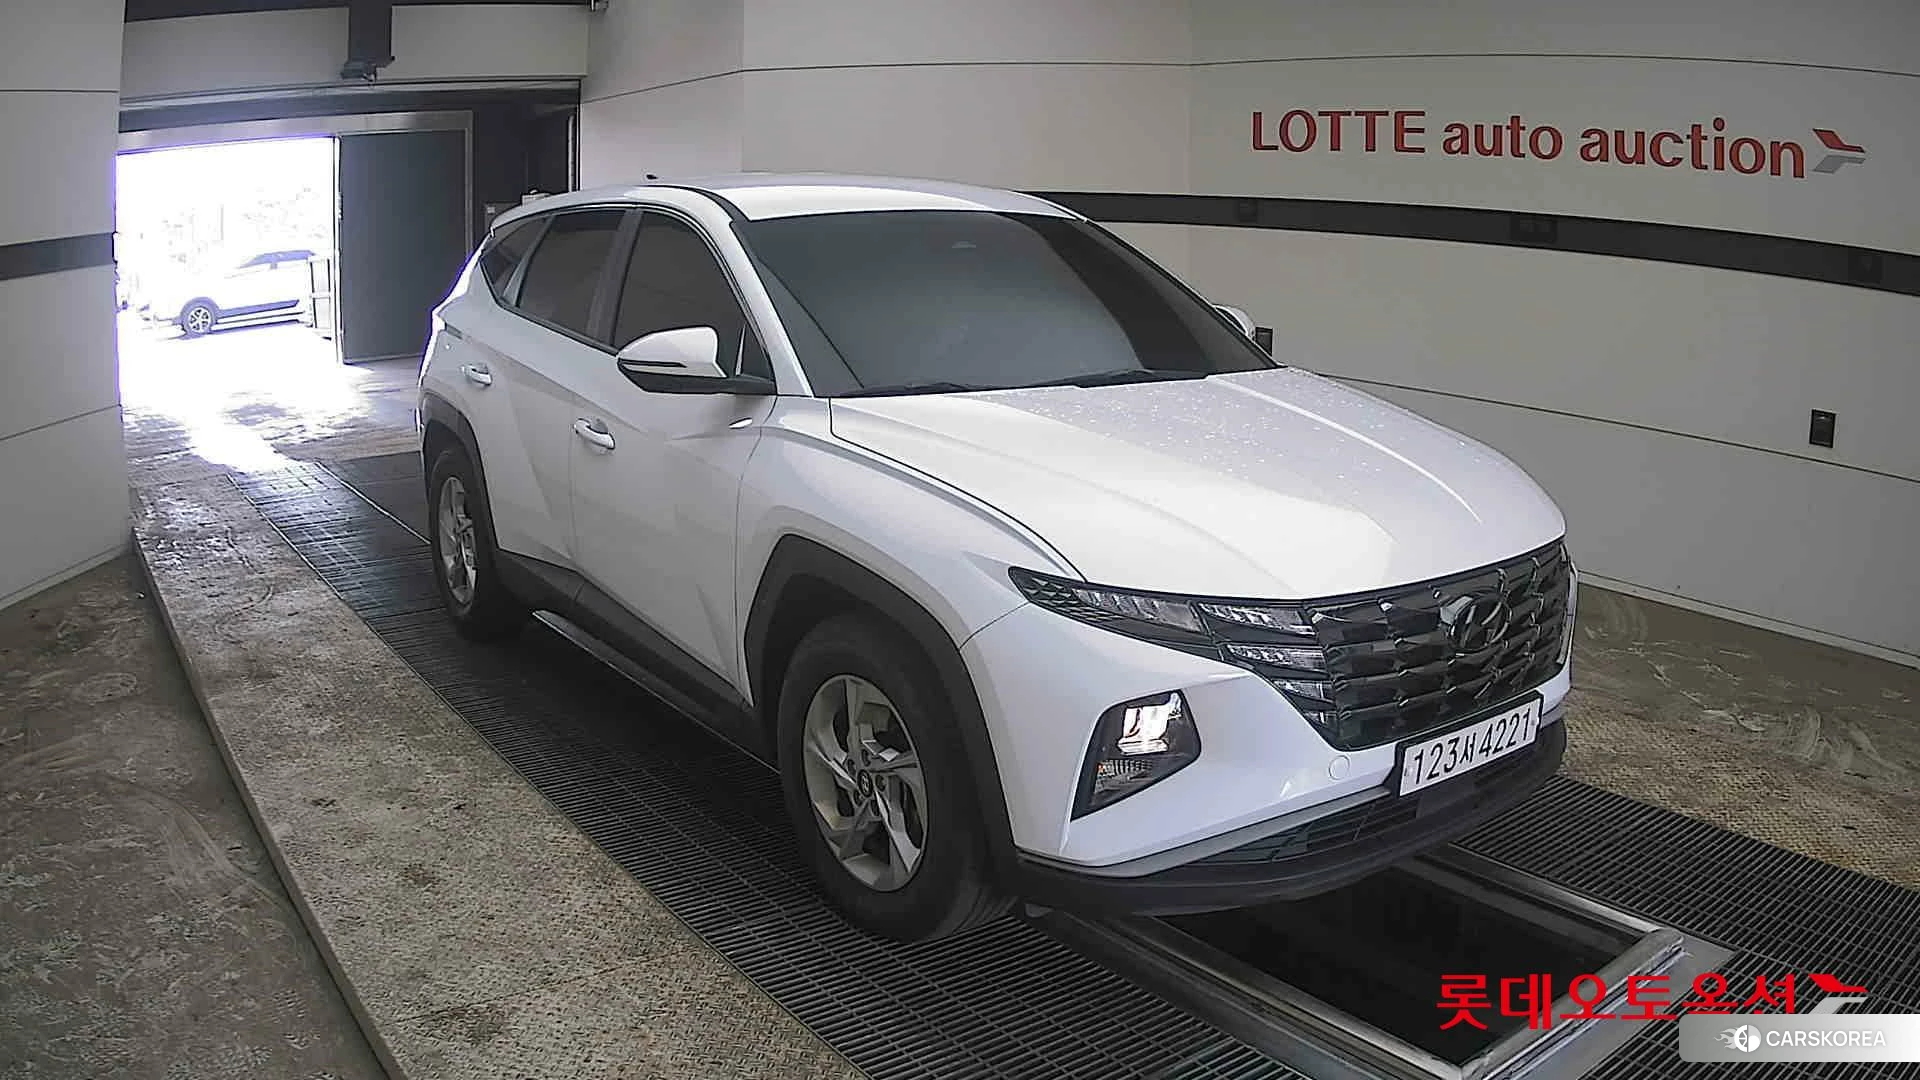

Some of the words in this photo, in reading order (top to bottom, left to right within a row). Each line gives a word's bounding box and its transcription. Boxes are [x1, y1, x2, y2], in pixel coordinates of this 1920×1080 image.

[1252, 110, 1426, 154] LOTTE
[1442, 115, 1564, 160] auto
[1578, 117, 1806, 179] auction
